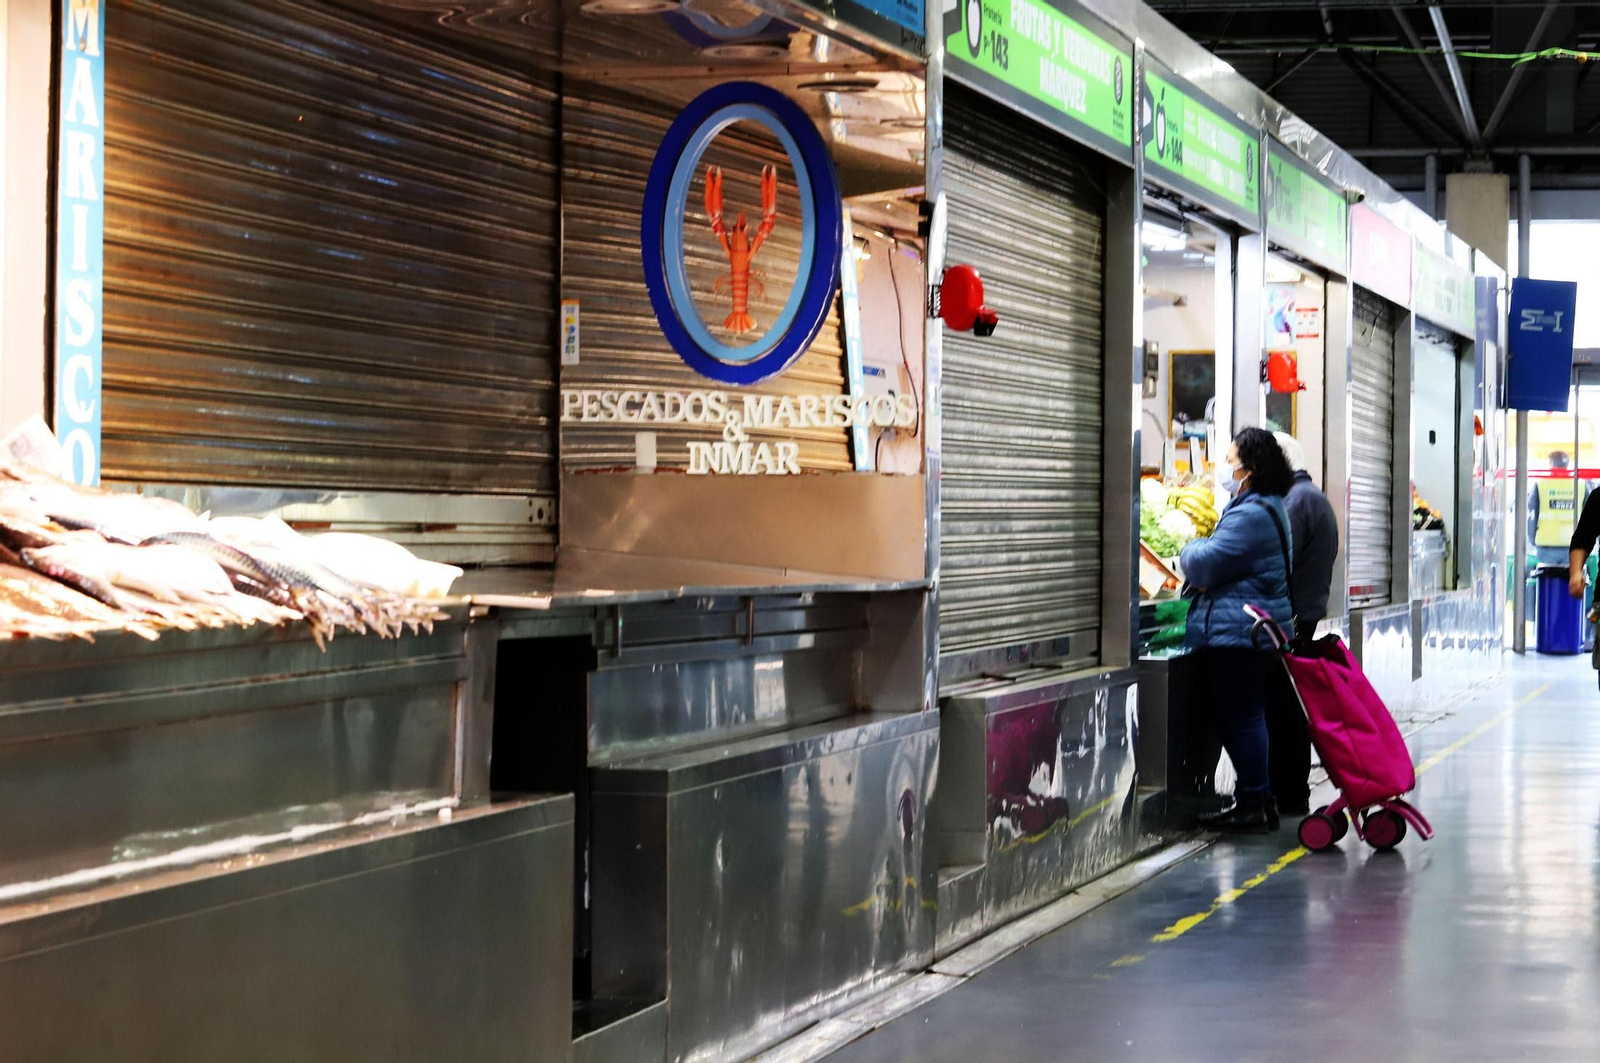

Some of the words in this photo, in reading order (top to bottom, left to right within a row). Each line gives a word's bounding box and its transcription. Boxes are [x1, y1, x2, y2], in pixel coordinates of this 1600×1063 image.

[1010, 0, 1051, 51] FRUTAS
[1053, 19, 1062, 54] Y
[1063, 24, 1111, 86] VERDURAS
[1039, 52, 1087, 115] MÁRQUEZ
[61, 0, 100, 486] MARISCO
[561, 389, 728, 423] PESCADOS
[723, 410, 749, 443] &
[743, 393, 917, 428] MARISCOS
[686, 441, 801, 476] INMAR
